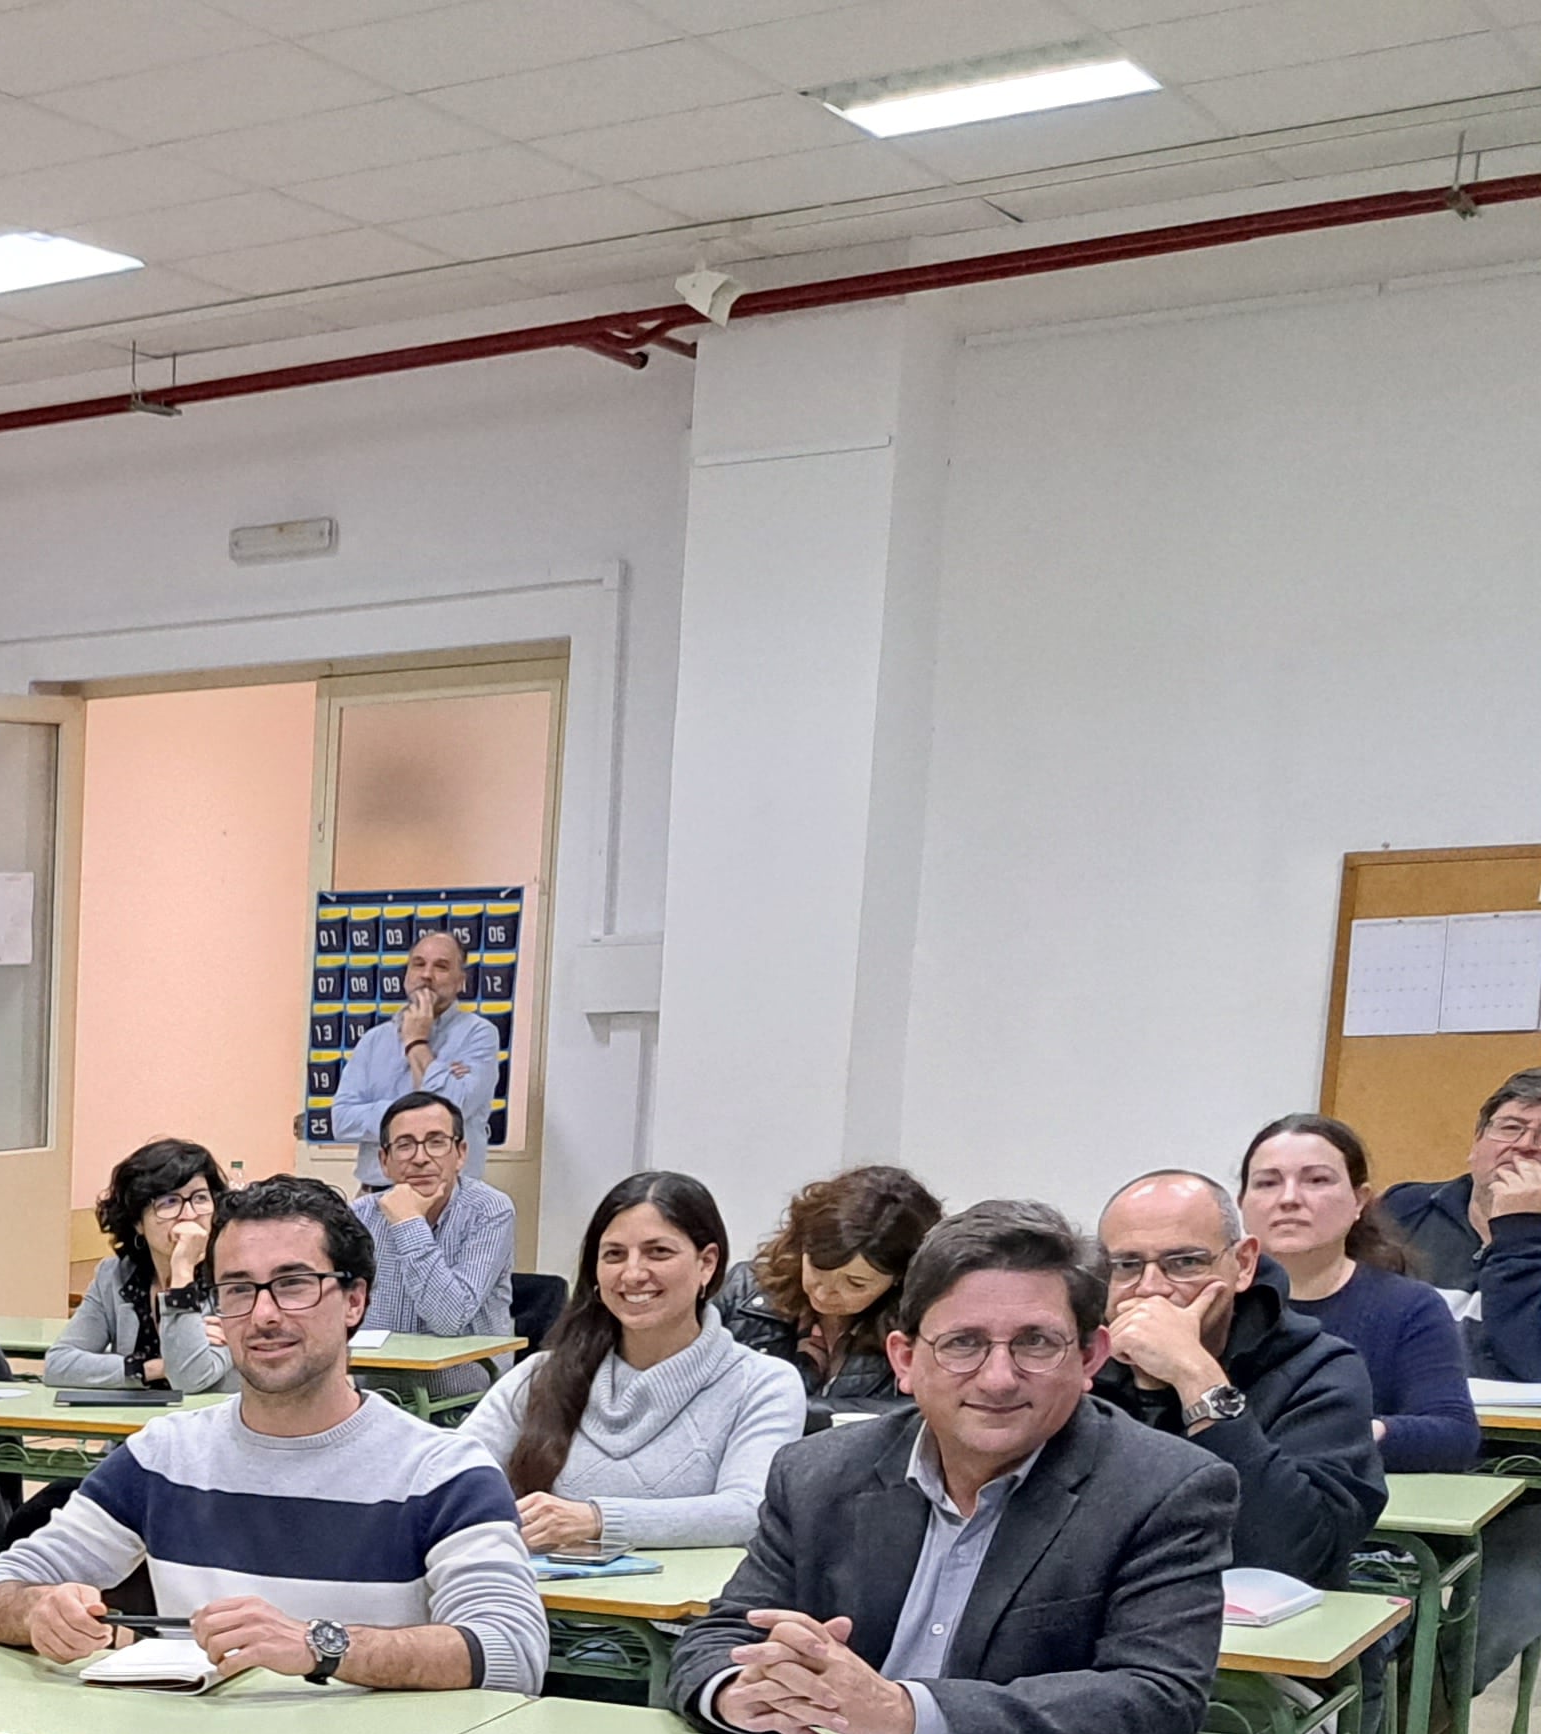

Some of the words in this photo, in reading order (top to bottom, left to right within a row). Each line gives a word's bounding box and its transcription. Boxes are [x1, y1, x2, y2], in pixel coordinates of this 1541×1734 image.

[319, 930, 337, 946] 01
[352, 930, 369, 946] 02
[386, 928, 403, 945] 03
[488, 925, 505, 943] 06
[318, 977, 334, 993] 07
[351, 976, 368, 993] 08
[383, 976, 400, 993] 09
[485, 975, 502, 992] 12
[315, 1024, 333, 1041] 13
[313, 1071, 330, 1088] 19
[310, 1118, 328, 1134] 25
